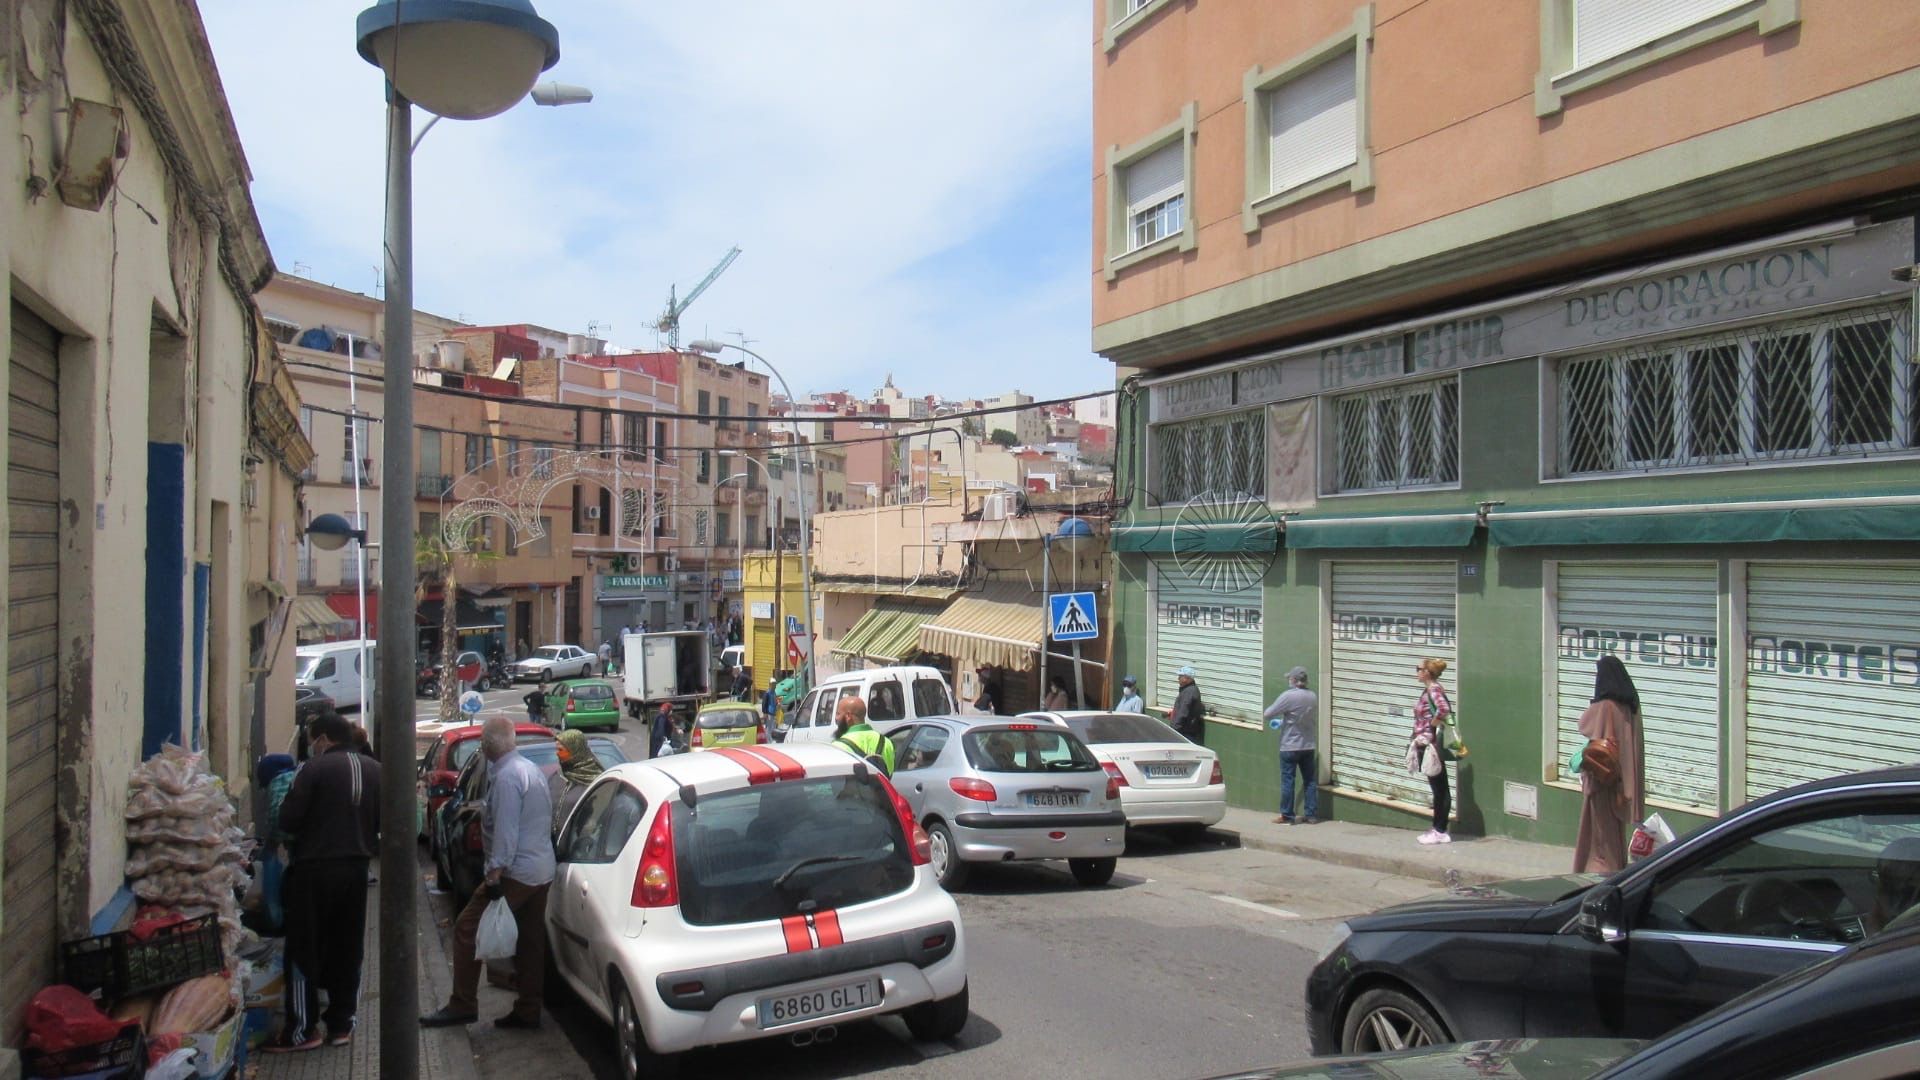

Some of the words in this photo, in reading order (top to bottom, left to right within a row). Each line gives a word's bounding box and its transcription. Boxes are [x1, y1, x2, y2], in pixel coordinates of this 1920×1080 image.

[1565, 244, 1833, 328] DECORACION
[612, 575, 663, 587] FARMACIA
[1151, 766, 1172, 776] 0709
[773, 993, 824, 1019] 6860
[831, 984, 867, 1008] GLT
